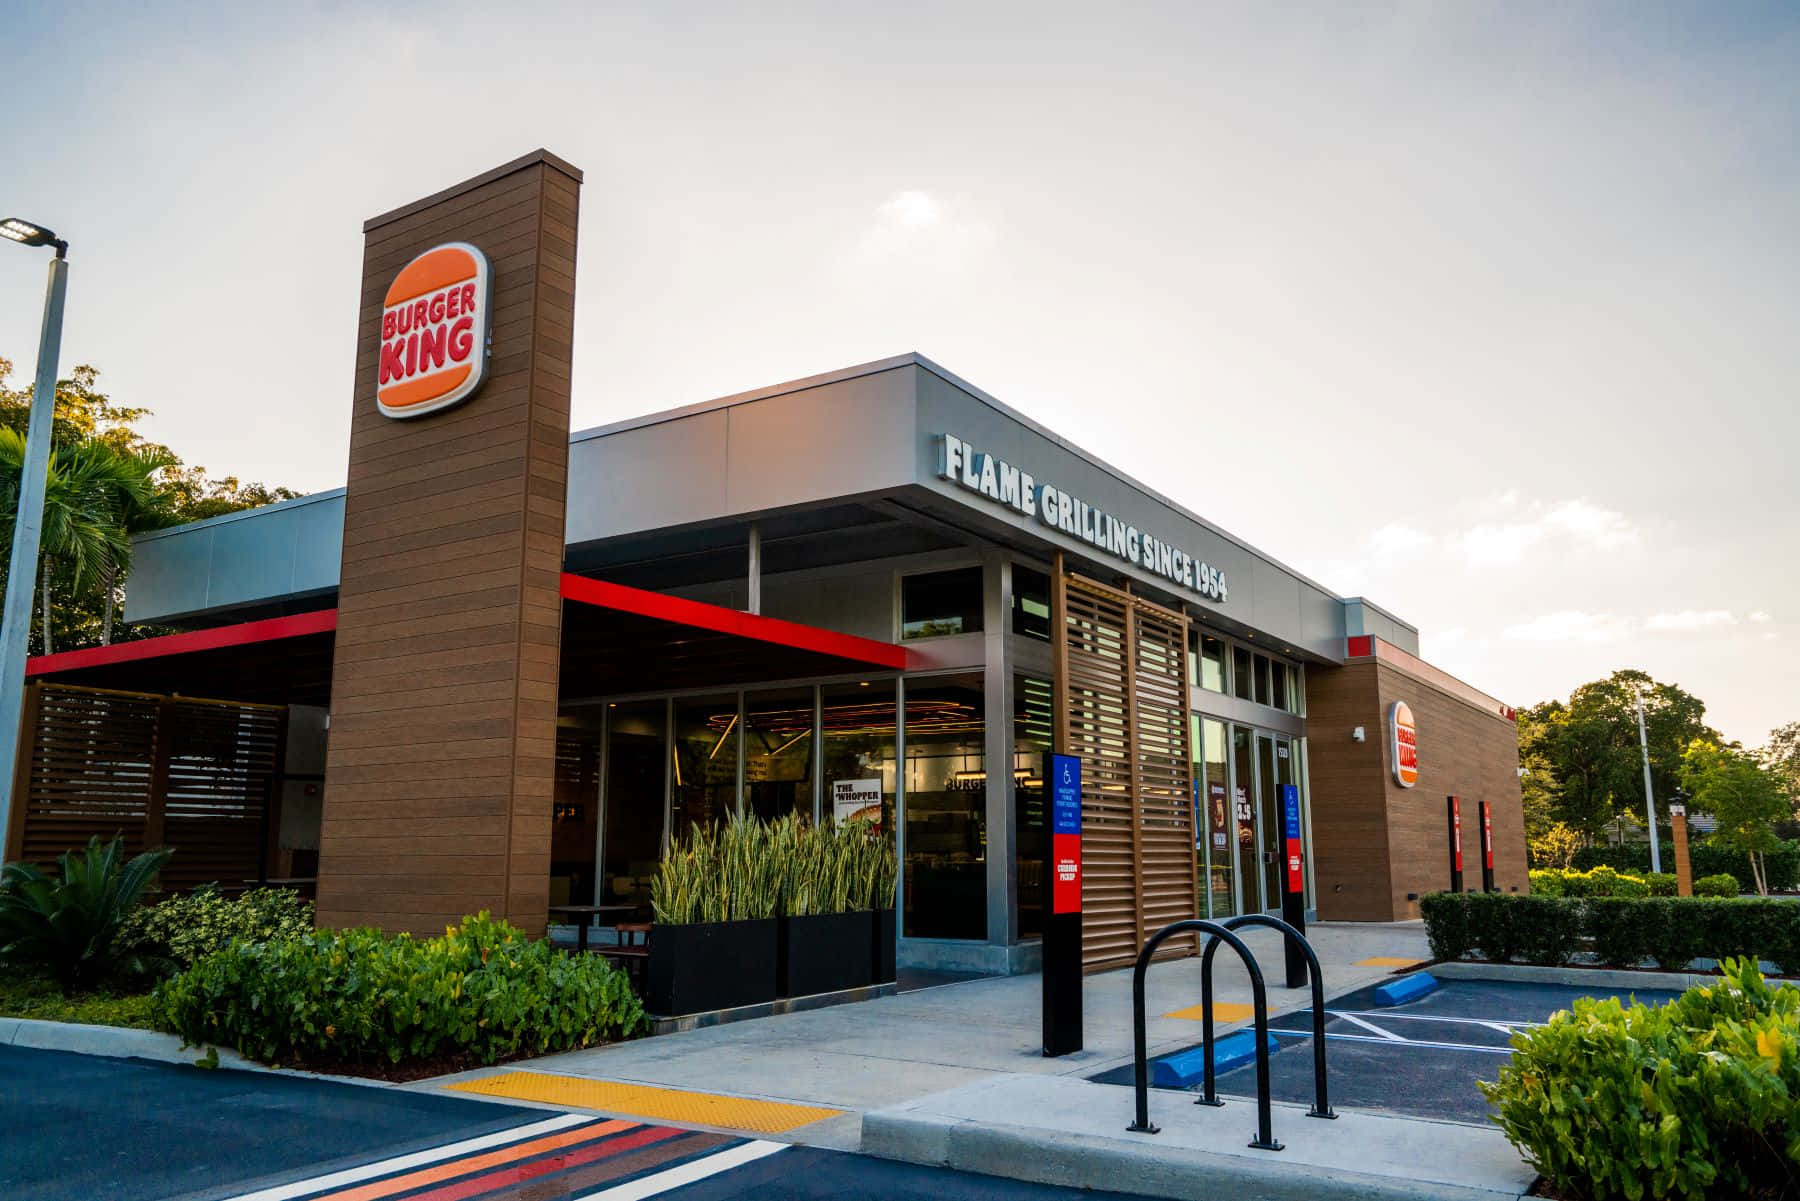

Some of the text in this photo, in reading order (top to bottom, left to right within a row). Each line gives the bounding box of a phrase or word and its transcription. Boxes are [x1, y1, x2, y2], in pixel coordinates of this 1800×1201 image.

[382, 283, 476, 341] BURGER
[379, 316, 474, 385] KING
[943, 433, 1228, 603] FLAME GRILLING SINCE 1954
[835, 791, 879, 801] WHOPPER
[836, 784, 853, 793] THE
[945, 778, 987, 792] BURGE
